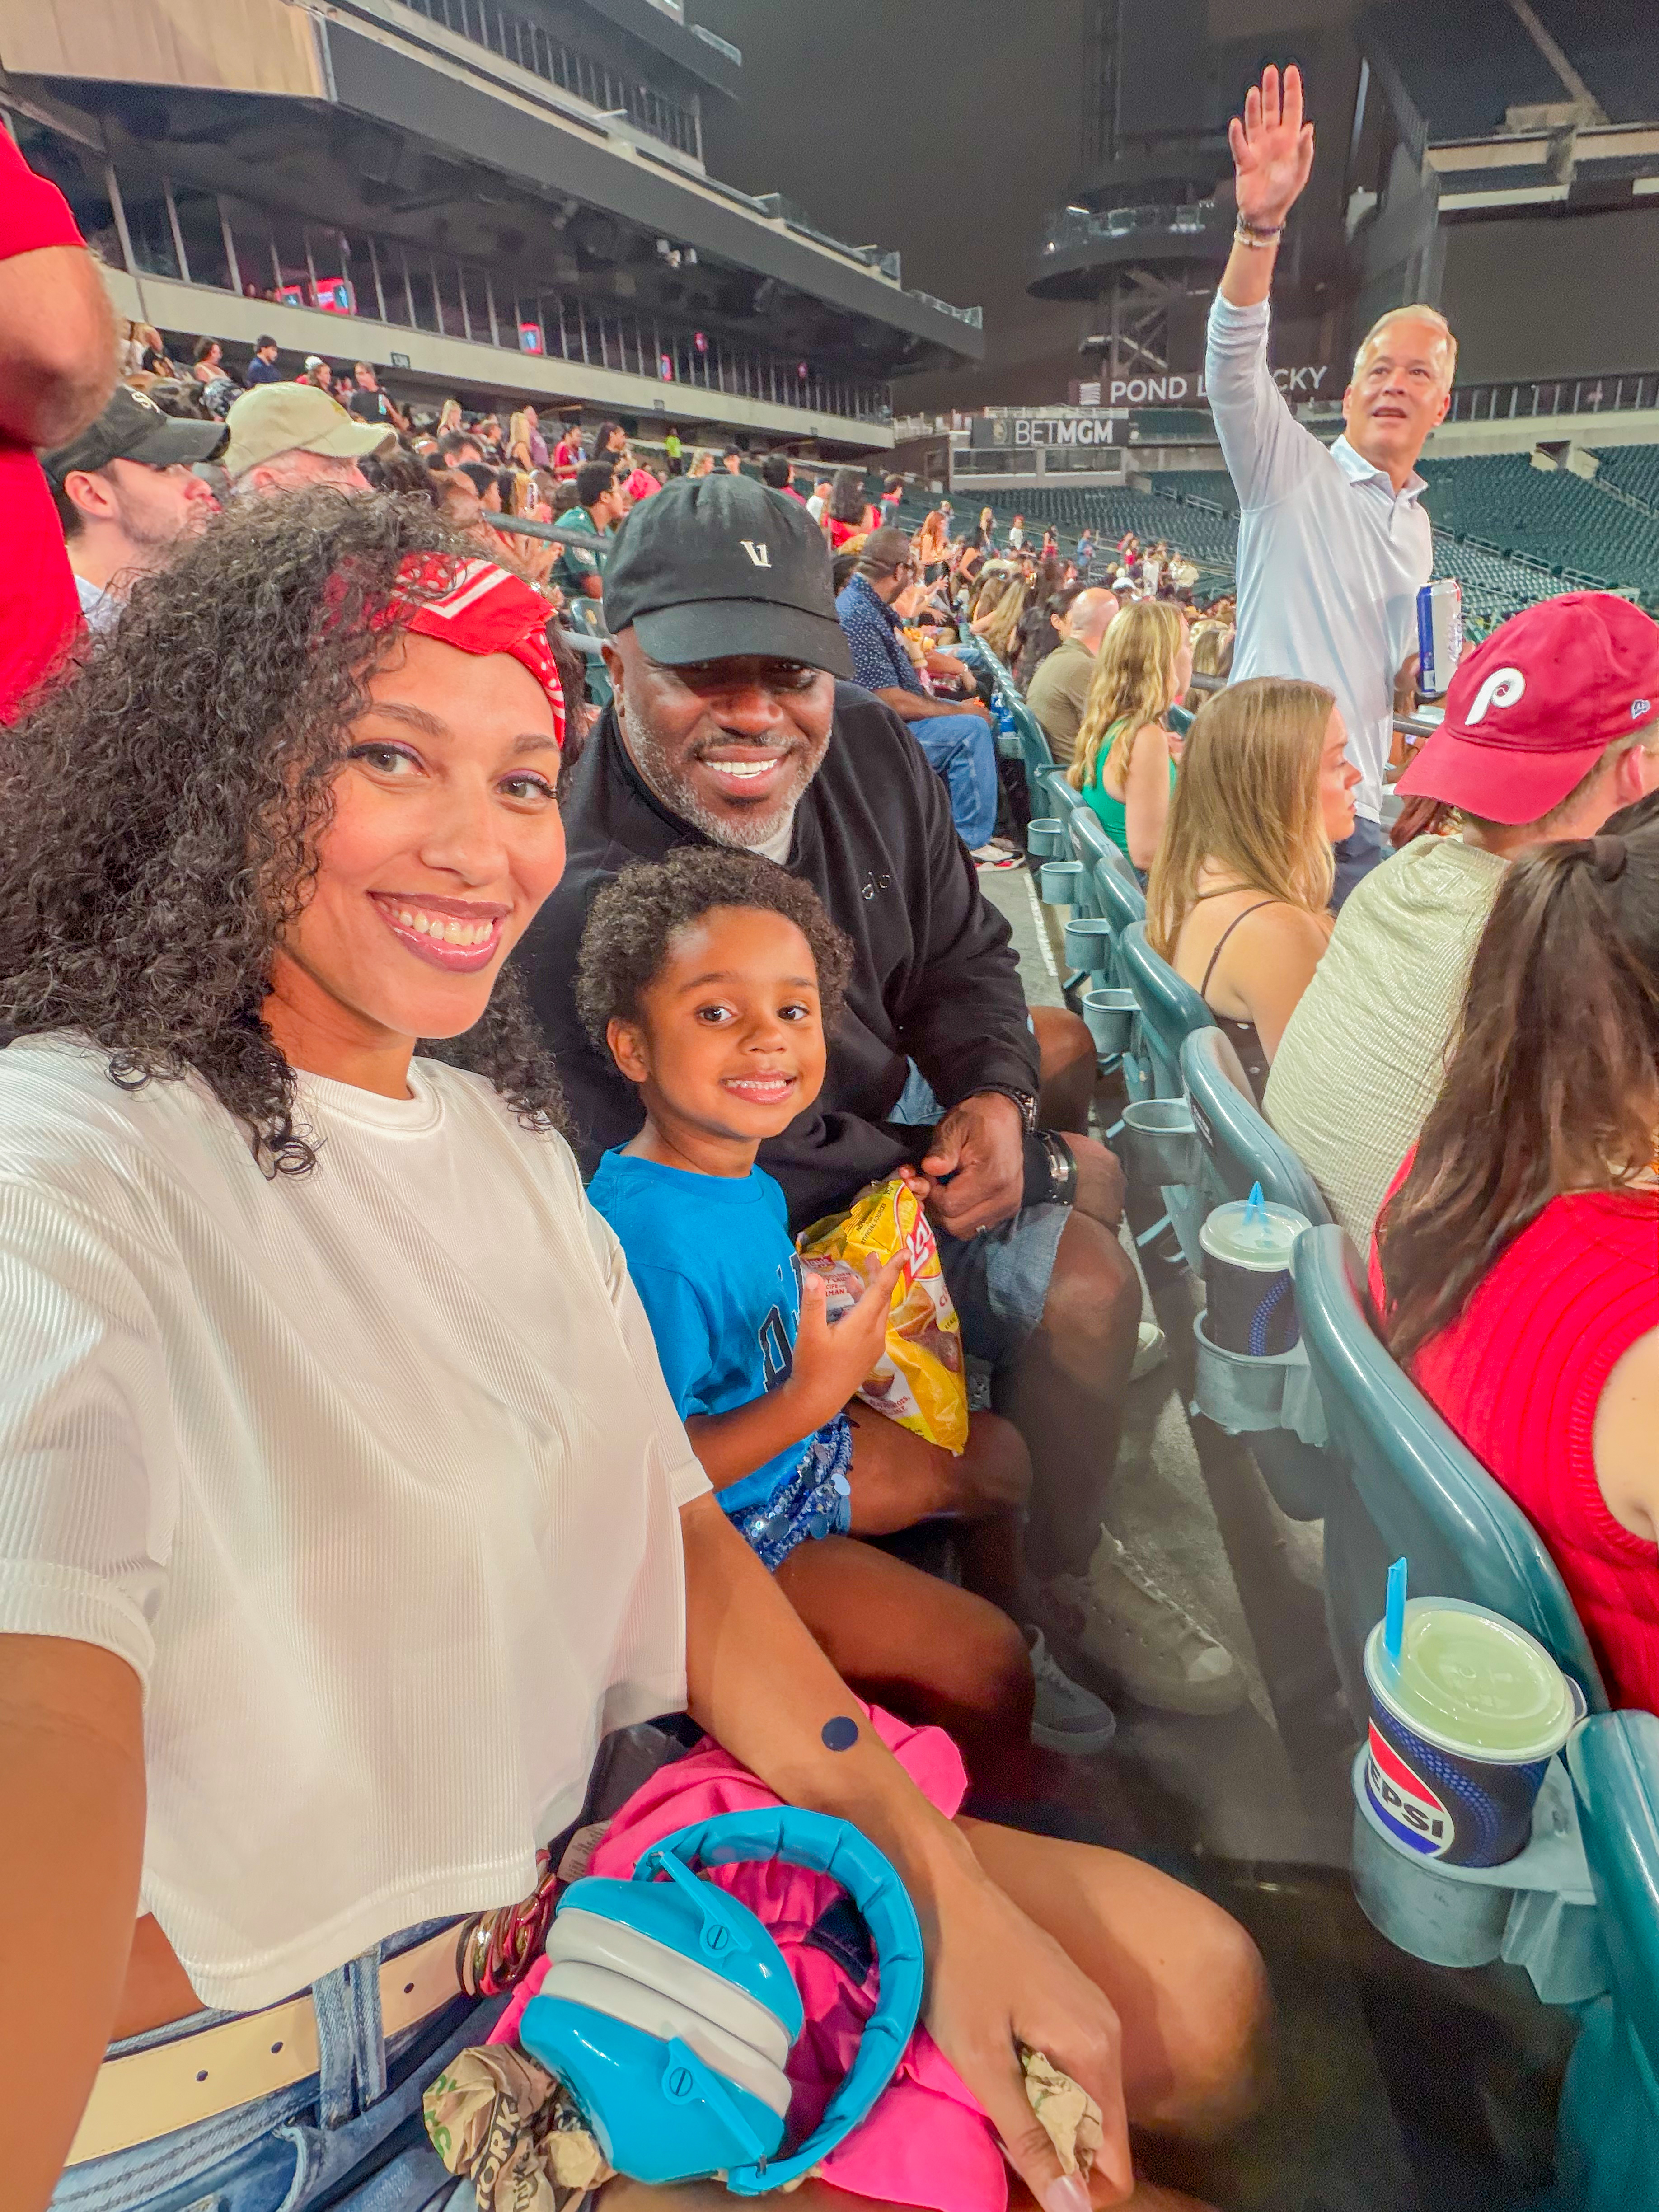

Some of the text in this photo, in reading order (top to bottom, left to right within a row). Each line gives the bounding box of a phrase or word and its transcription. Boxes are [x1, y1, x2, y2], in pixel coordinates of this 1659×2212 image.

[1111, 366, 1327, 404] POND LCKY
[1015, 419, 1114, 444] BETMGM
[1464, 667, 1526, 726] P
[861, 1222, 876, 1244] RTIFICIAL
[874, 1202, 886, 1223] SOURCES
[1368, 1757, 1443, 1839] EPSI
